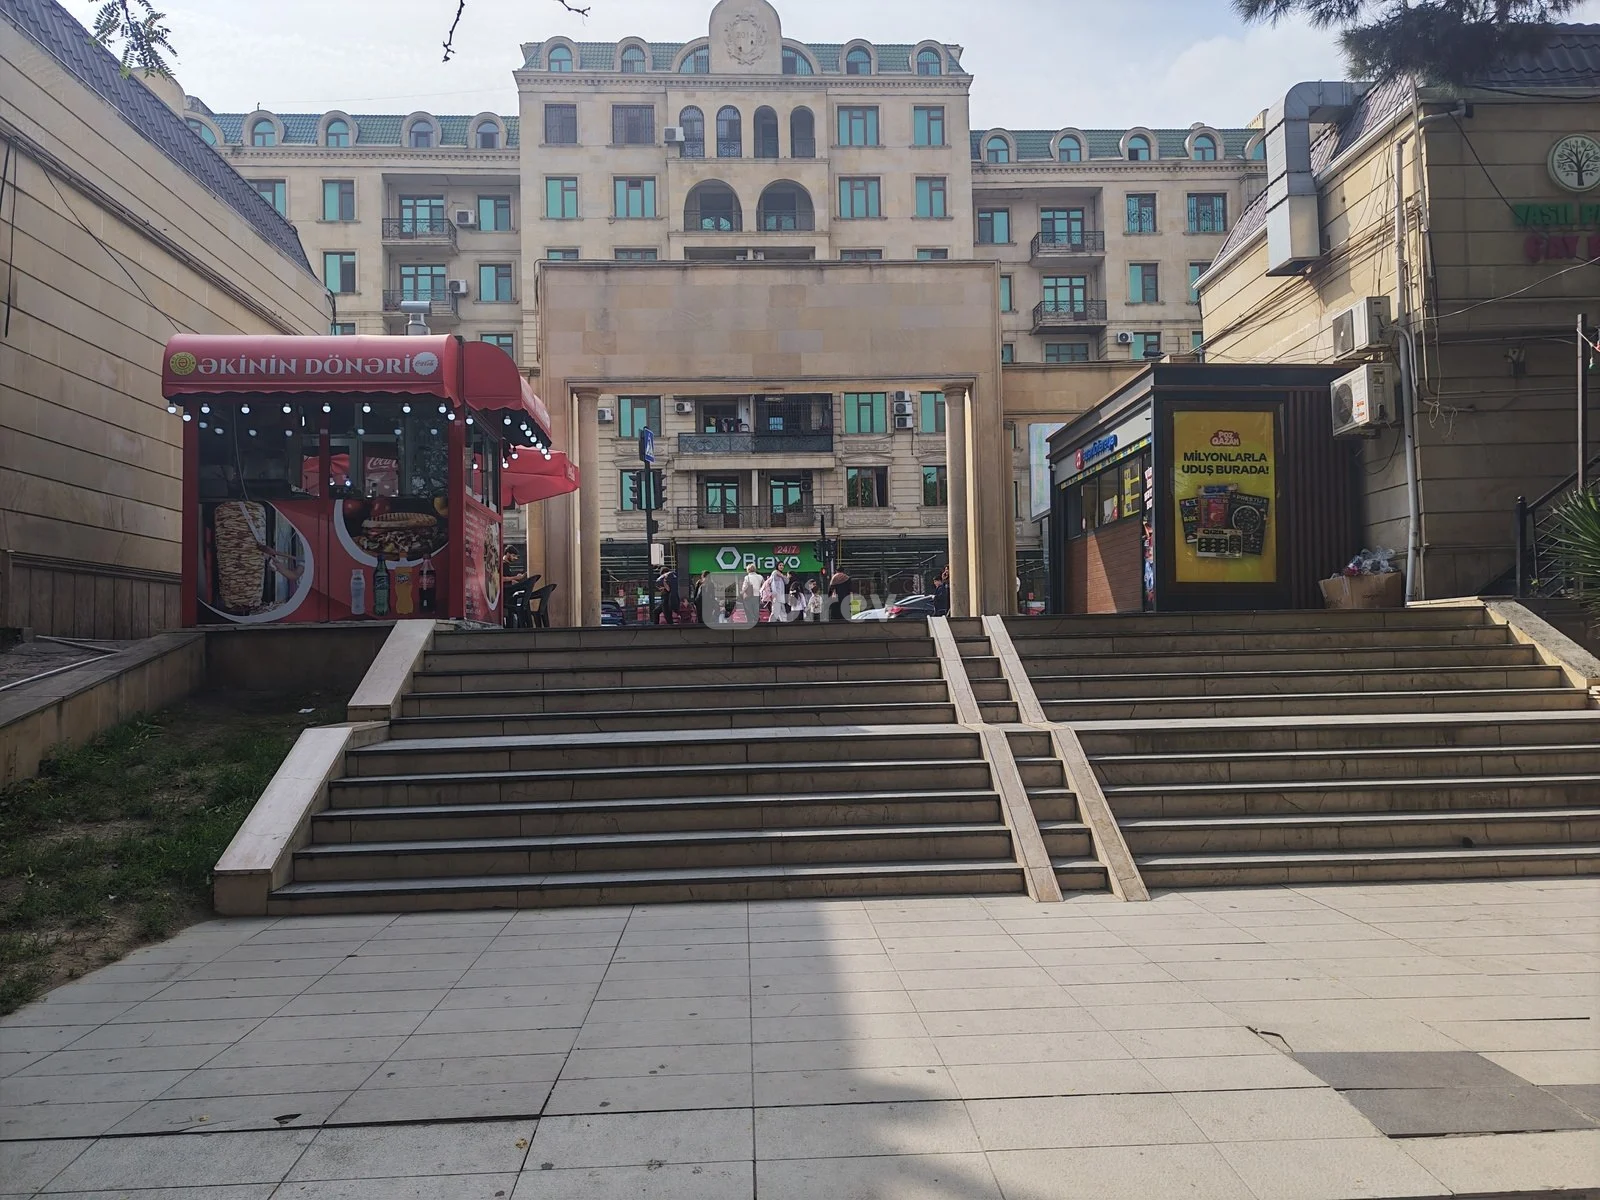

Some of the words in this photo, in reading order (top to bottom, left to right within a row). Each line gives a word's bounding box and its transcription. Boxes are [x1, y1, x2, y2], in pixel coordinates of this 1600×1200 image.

[198, 354, 297, 375] ƏKİNİN
[305, 354, 412, 375] DÖNƏRİ
[1183, 450, 1267, 462] MİLYONLARLA
[1182, 465, 1214, 476] UDUŞ
[1216, 465, 1269, 475] BURADA!
[777, 545, 797, 554] 24/7
[743, 553, 801, 570] Bravo
